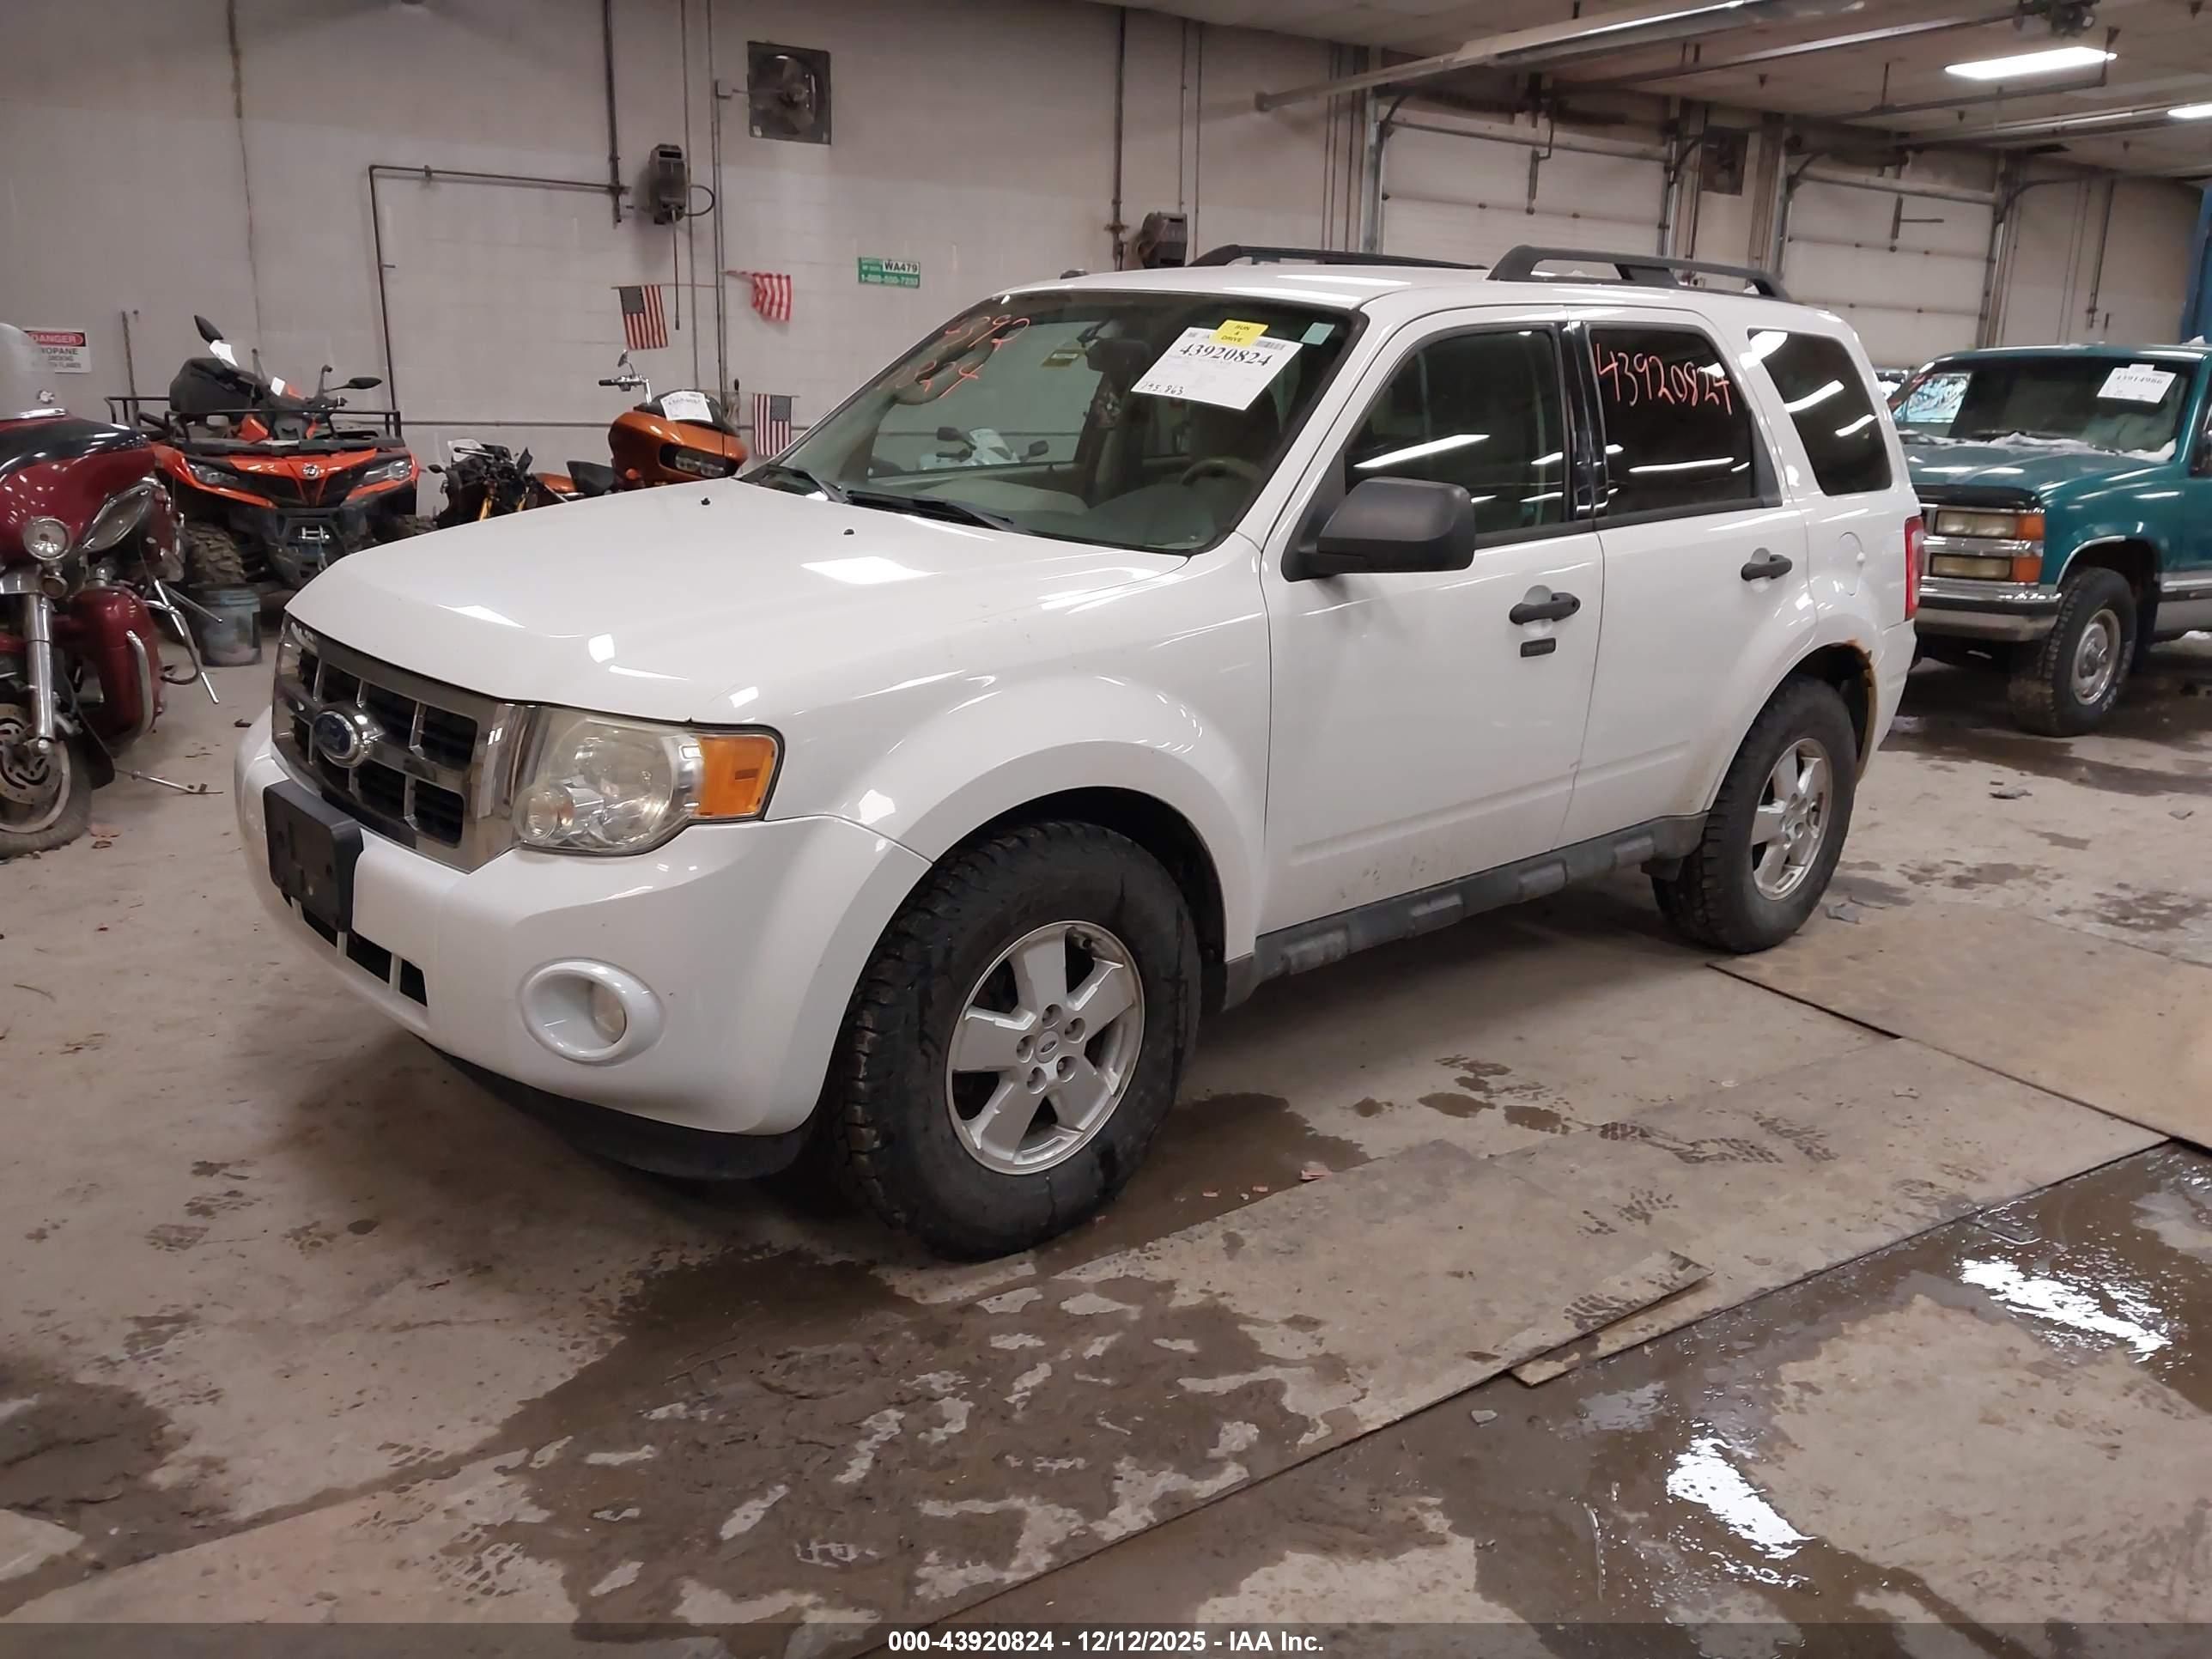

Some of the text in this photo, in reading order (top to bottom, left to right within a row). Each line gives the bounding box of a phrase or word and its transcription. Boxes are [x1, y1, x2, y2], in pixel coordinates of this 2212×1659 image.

[884, 261, 918, 273] WA479
[31, 334, 76, 343] DANGER
[1180, 343, 1273, 367] 43920824
[1595, 343, 1734, 416] 43920824
